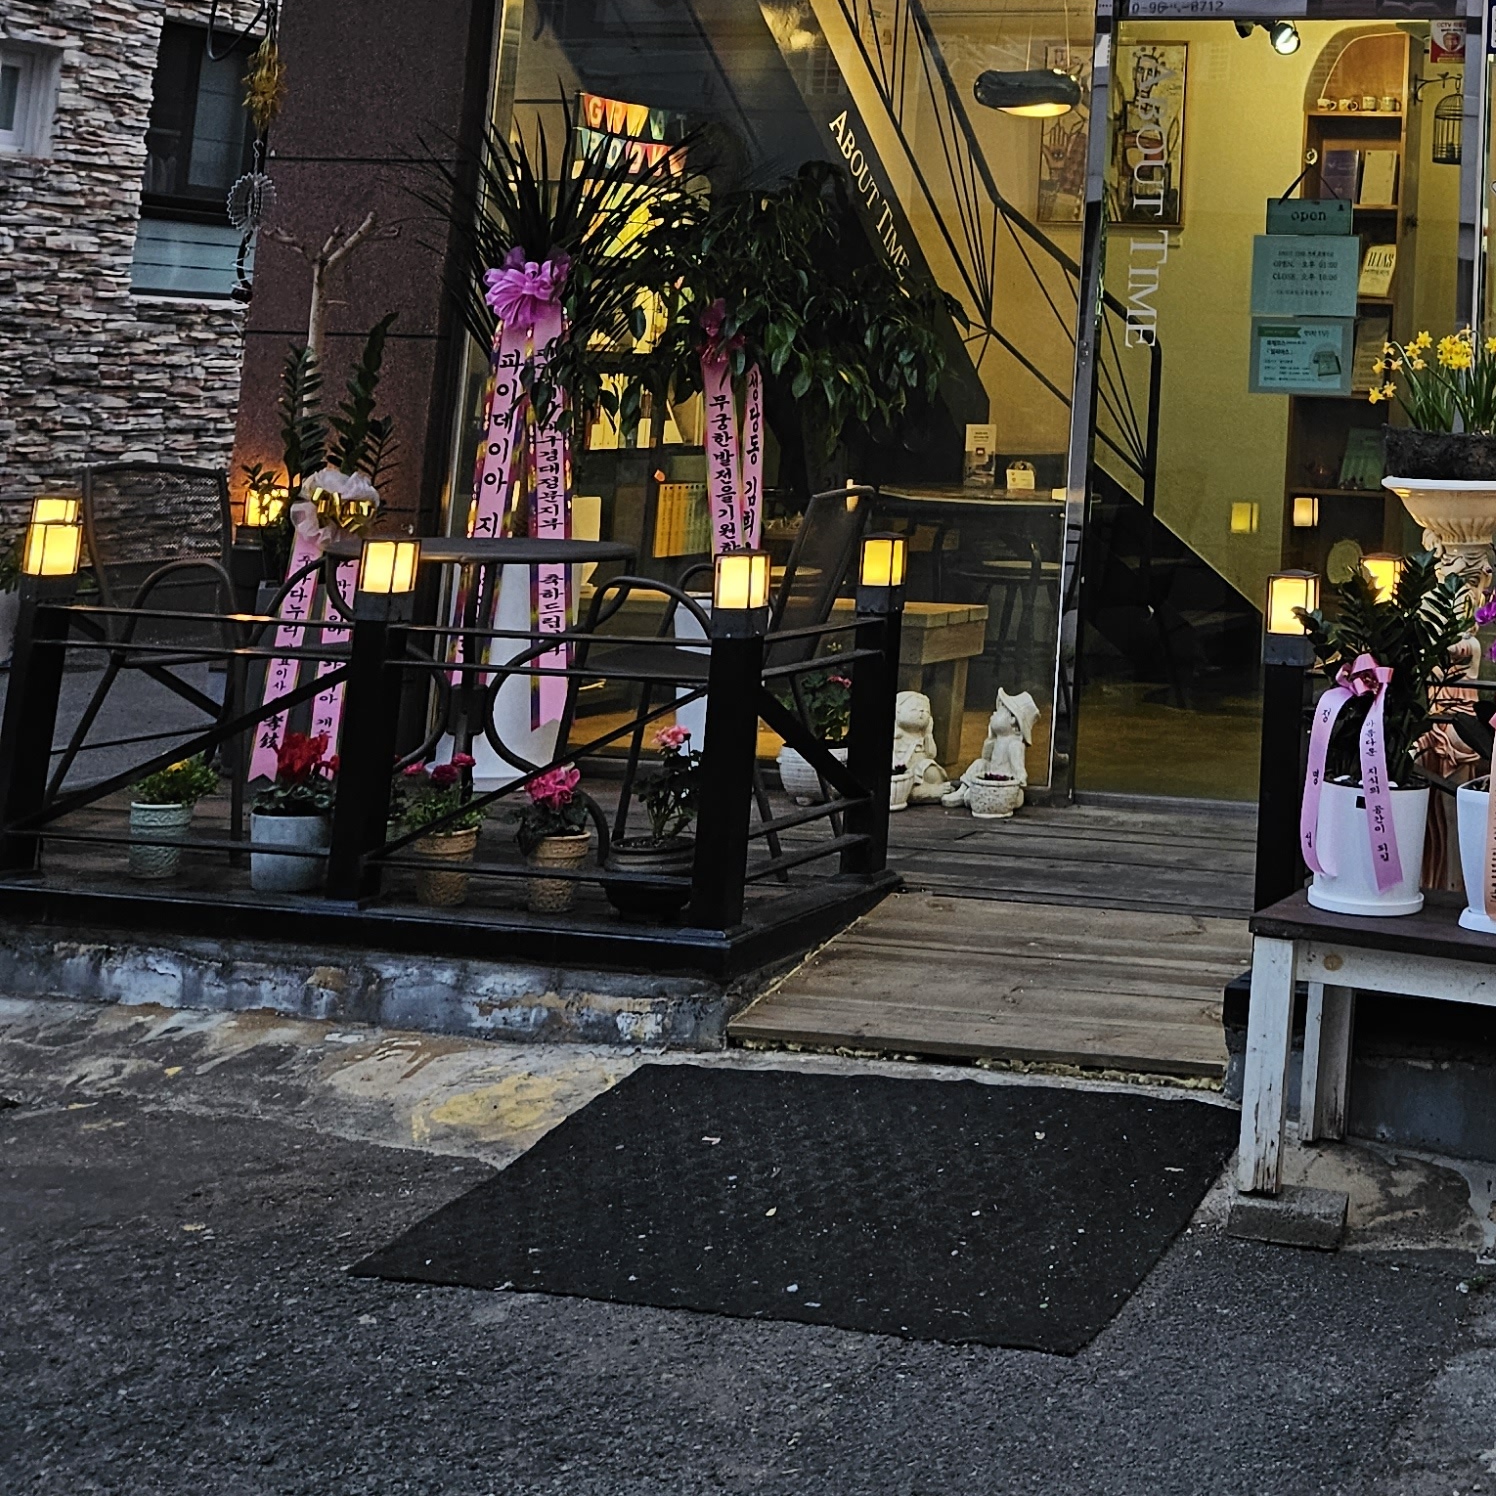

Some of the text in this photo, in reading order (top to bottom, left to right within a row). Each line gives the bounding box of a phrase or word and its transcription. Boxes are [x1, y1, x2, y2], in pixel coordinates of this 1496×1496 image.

[828, 109, 881, 208] ABOUT
[1125, 56, 1178, 349] ABOUT TIME
[1290, 209, 1327, 223] open
[483, 348, 525, 495] 파이데이아
